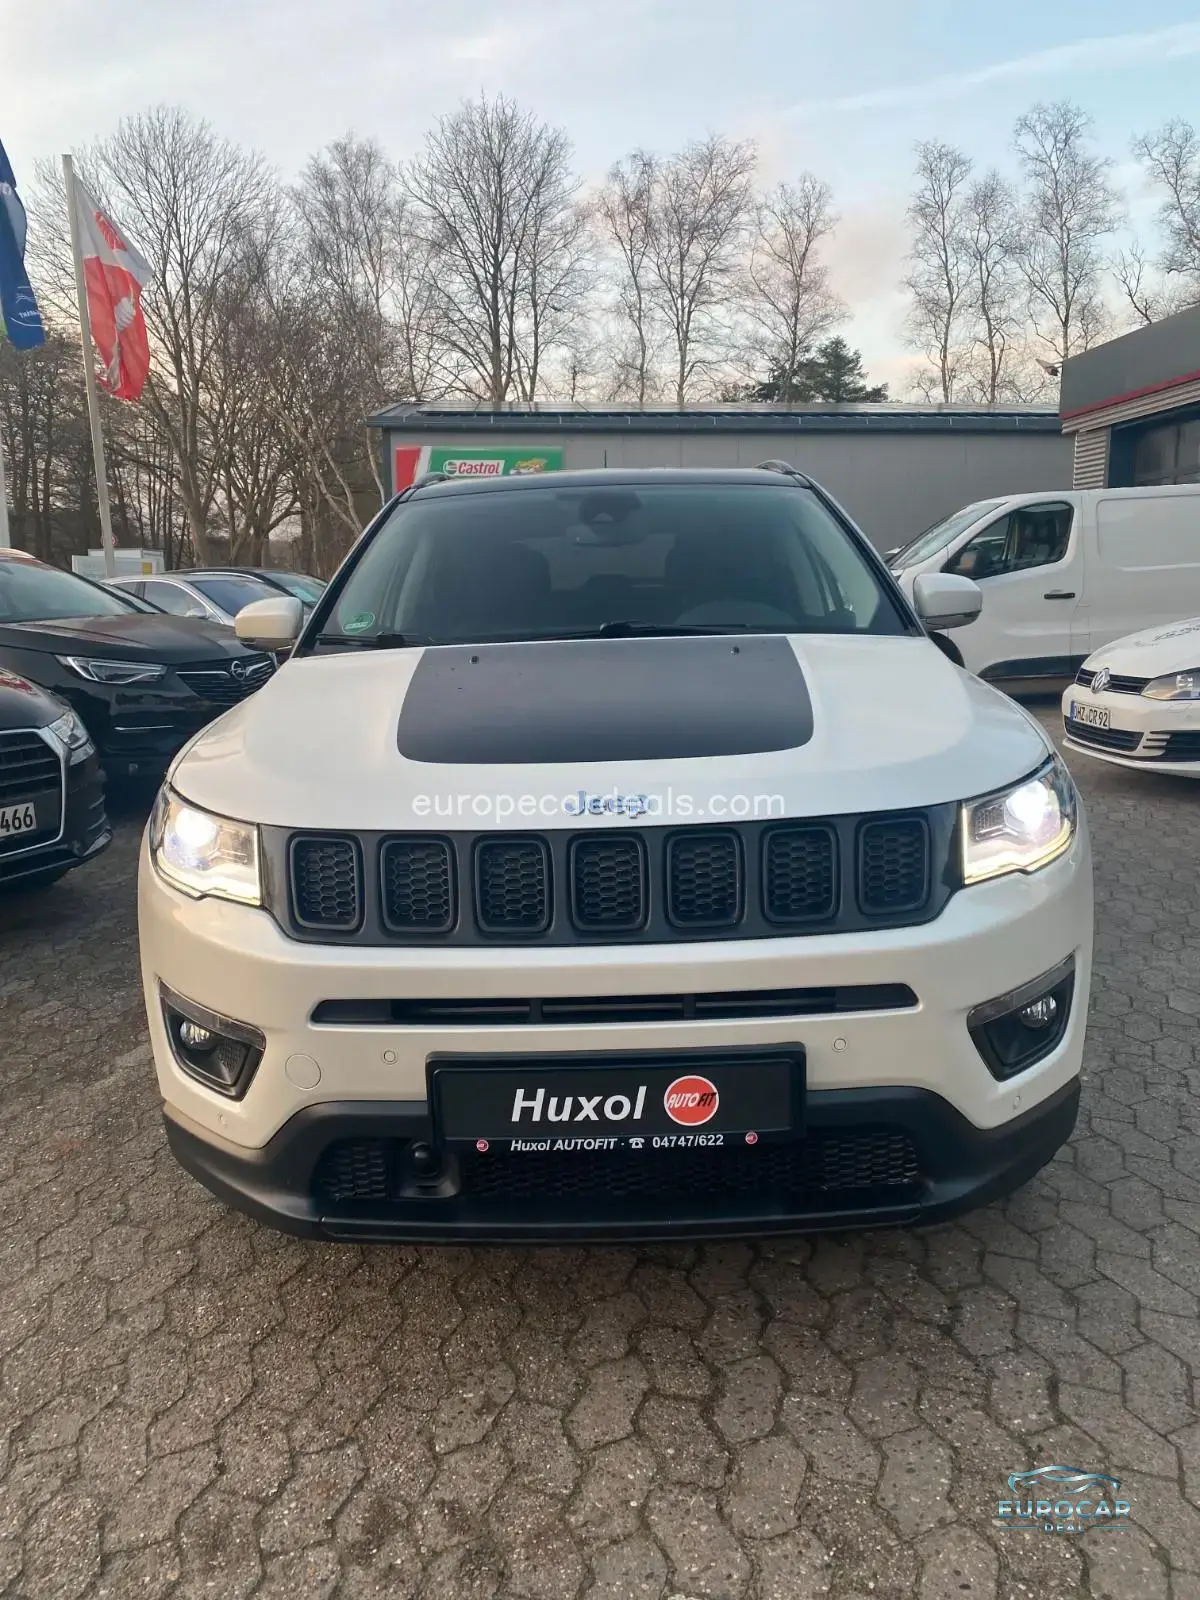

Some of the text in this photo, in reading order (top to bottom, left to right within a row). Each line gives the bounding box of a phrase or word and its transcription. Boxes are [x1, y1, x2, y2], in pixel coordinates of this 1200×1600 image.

[458, 461, 500, 475] Castrol
[1088, 708, 1097, 725] CR
[1098, 711, 1108, 727] 92
[0, 806, 34, 832] 466
[511, 1085, 648, 1123] Huxol
[667, 1092, 717, 1108] AUTOFIT
[510, 1134, 724, 1151] Huxol AUTOFIT 04747/622
